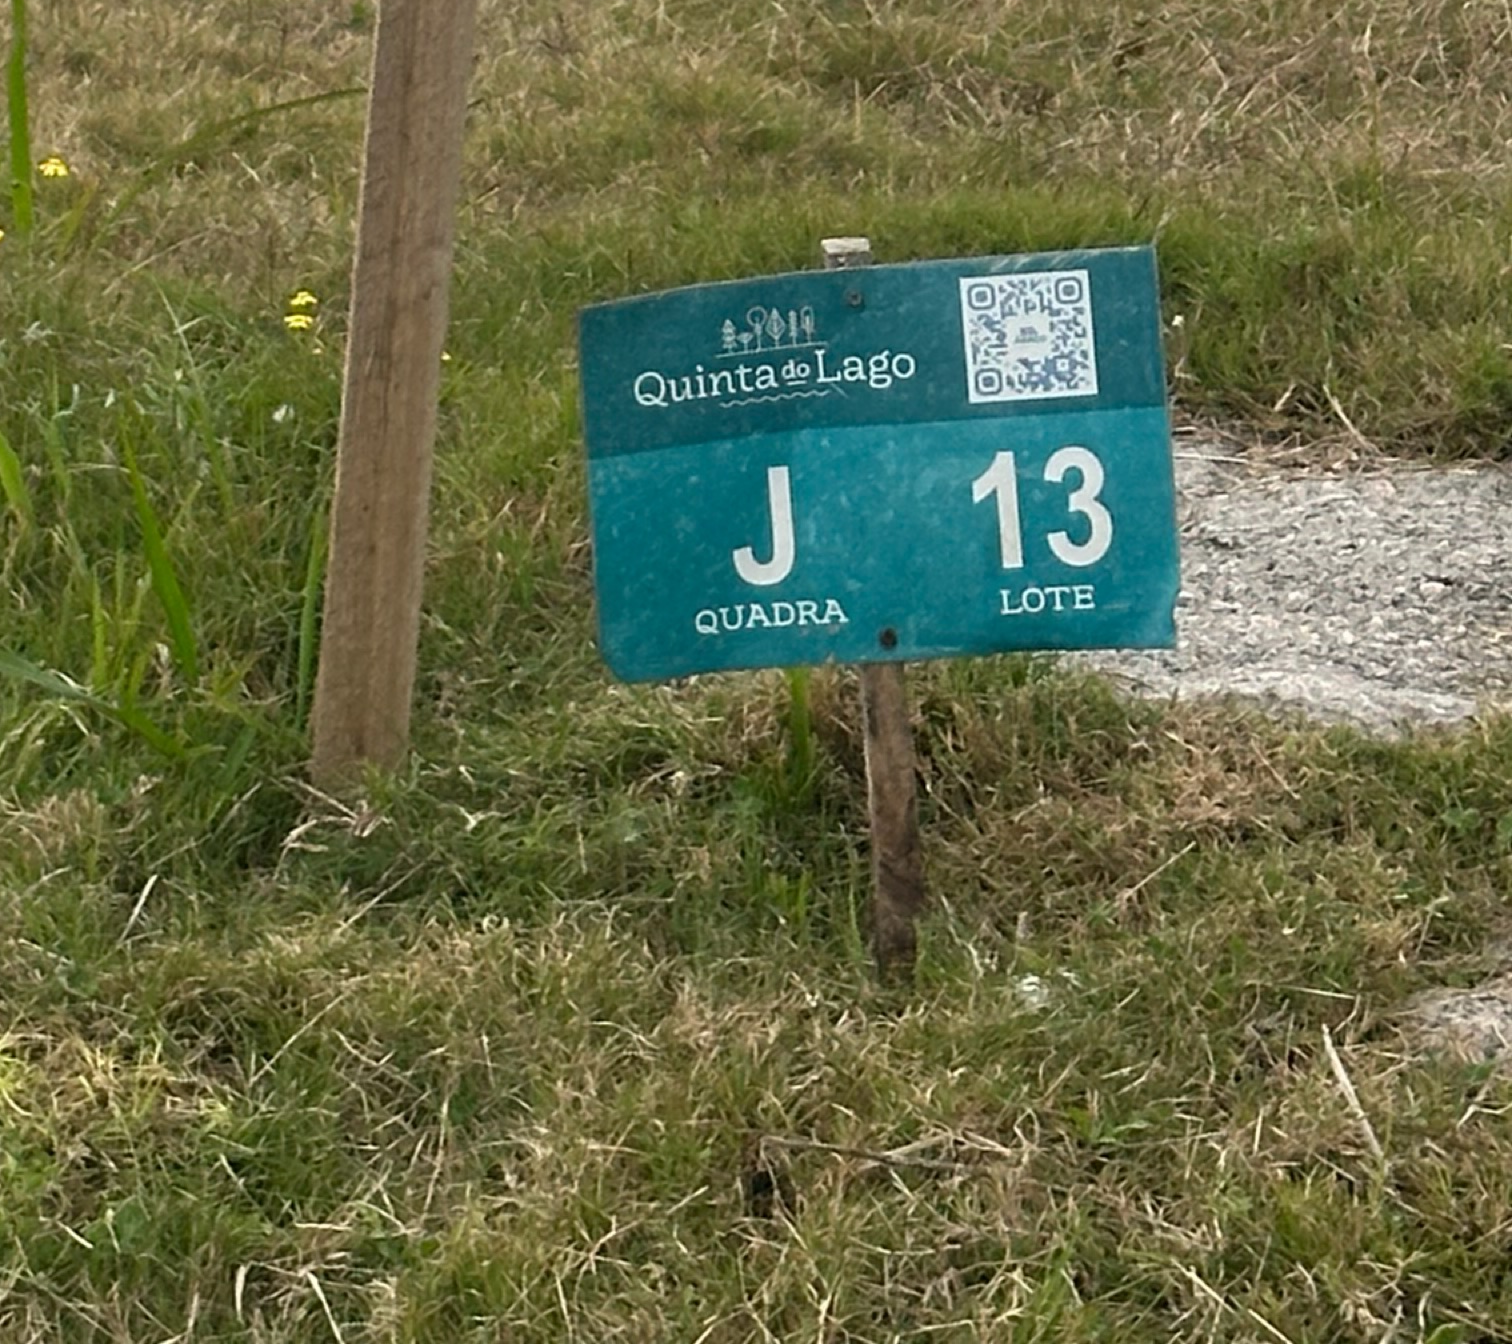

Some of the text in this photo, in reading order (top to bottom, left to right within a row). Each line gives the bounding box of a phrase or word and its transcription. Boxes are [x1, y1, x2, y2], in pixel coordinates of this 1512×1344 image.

[633, 348, 917, 408] Quinta do Lago
[731, 464, 797, 587] J
[971, 445, 1115, 571] 13
[694, 598, 850, 635] QUADRA
[999, 583, 1097, 617] LOTE
